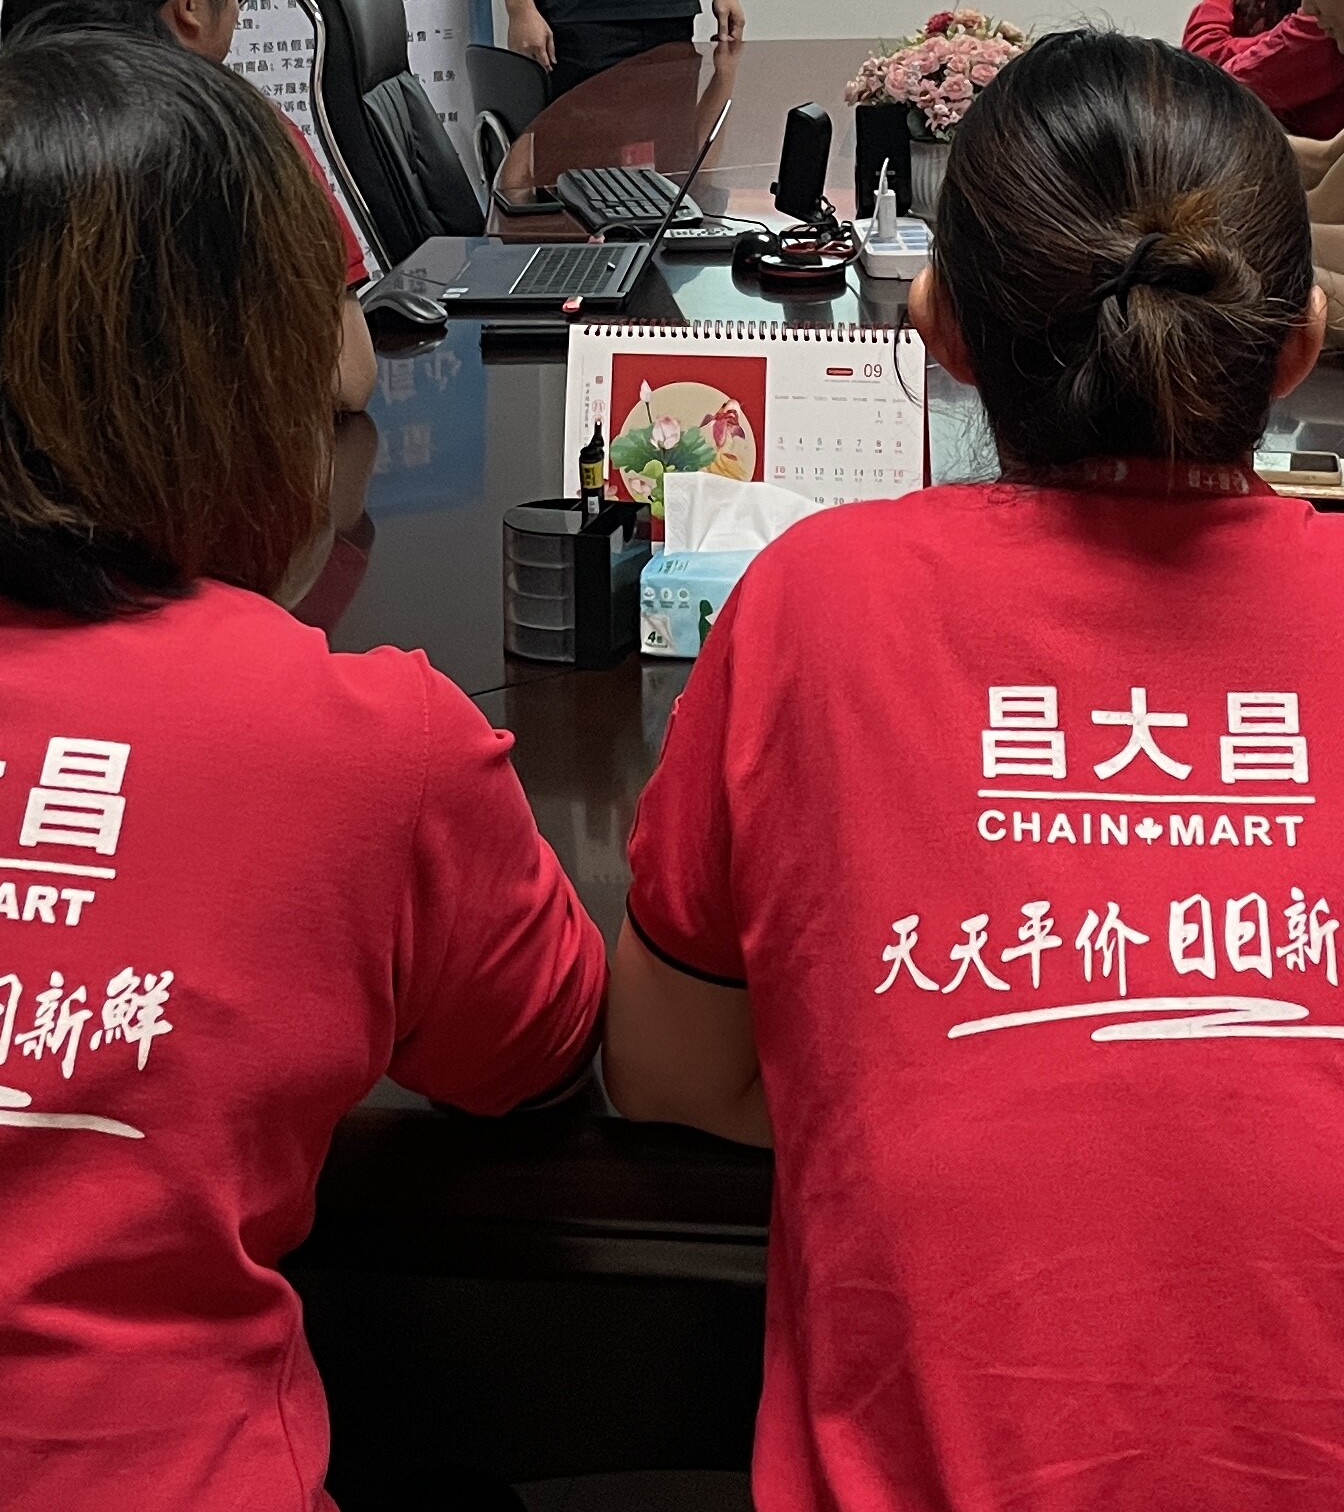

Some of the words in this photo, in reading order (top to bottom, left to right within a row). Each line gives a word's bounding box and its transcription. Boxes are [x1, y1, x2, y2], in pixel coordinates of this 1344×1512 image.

[863, 363, 883, 378] 09
[778, 436, 784, 444] 3
[817, 438, 823, 446] 5
[856, 439, 862, 447] 7
[876, 440, 882, 448] 8
[775, 465, 786, 474] 10
[795, 466, 805, 475] 11
[814, 467, 825, 476] 12
[834, 468, 845, 476] 13
[854, 469, 864, 477] 14
[873, 469, 884, 478] 15
[893, 469, 904, 478] 16
[981, 685, 1309, 784] 昌大昌
[977, 808, 1129, 845] CHAIN
[1169, 813, 1305, 848] MART
